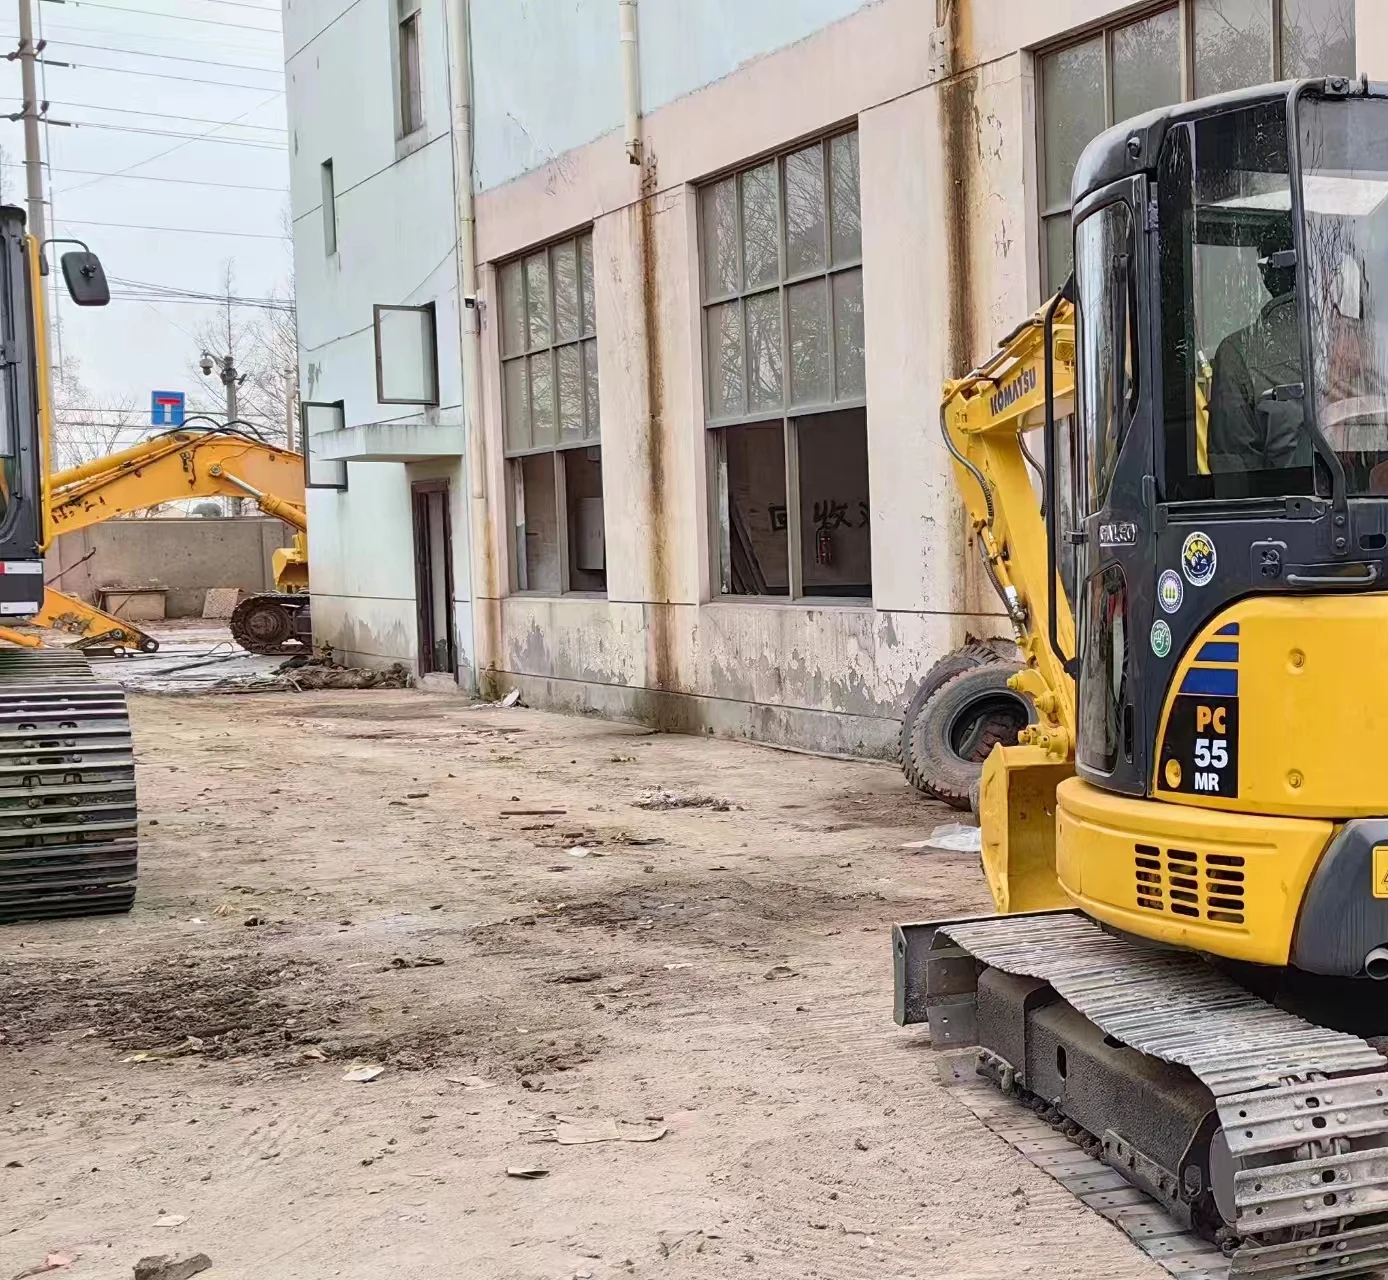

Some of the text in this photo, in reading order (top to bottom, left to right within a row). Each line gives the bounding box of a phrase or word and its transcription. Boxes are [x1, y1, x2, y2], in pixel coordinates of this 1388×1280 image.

[990, 367, 1036, 416] KOMATSU
[1196, 705, 1226, 734] PC
[1194, 738, 1228, 769] 55
[1194, 772, 1220, 791] MR
